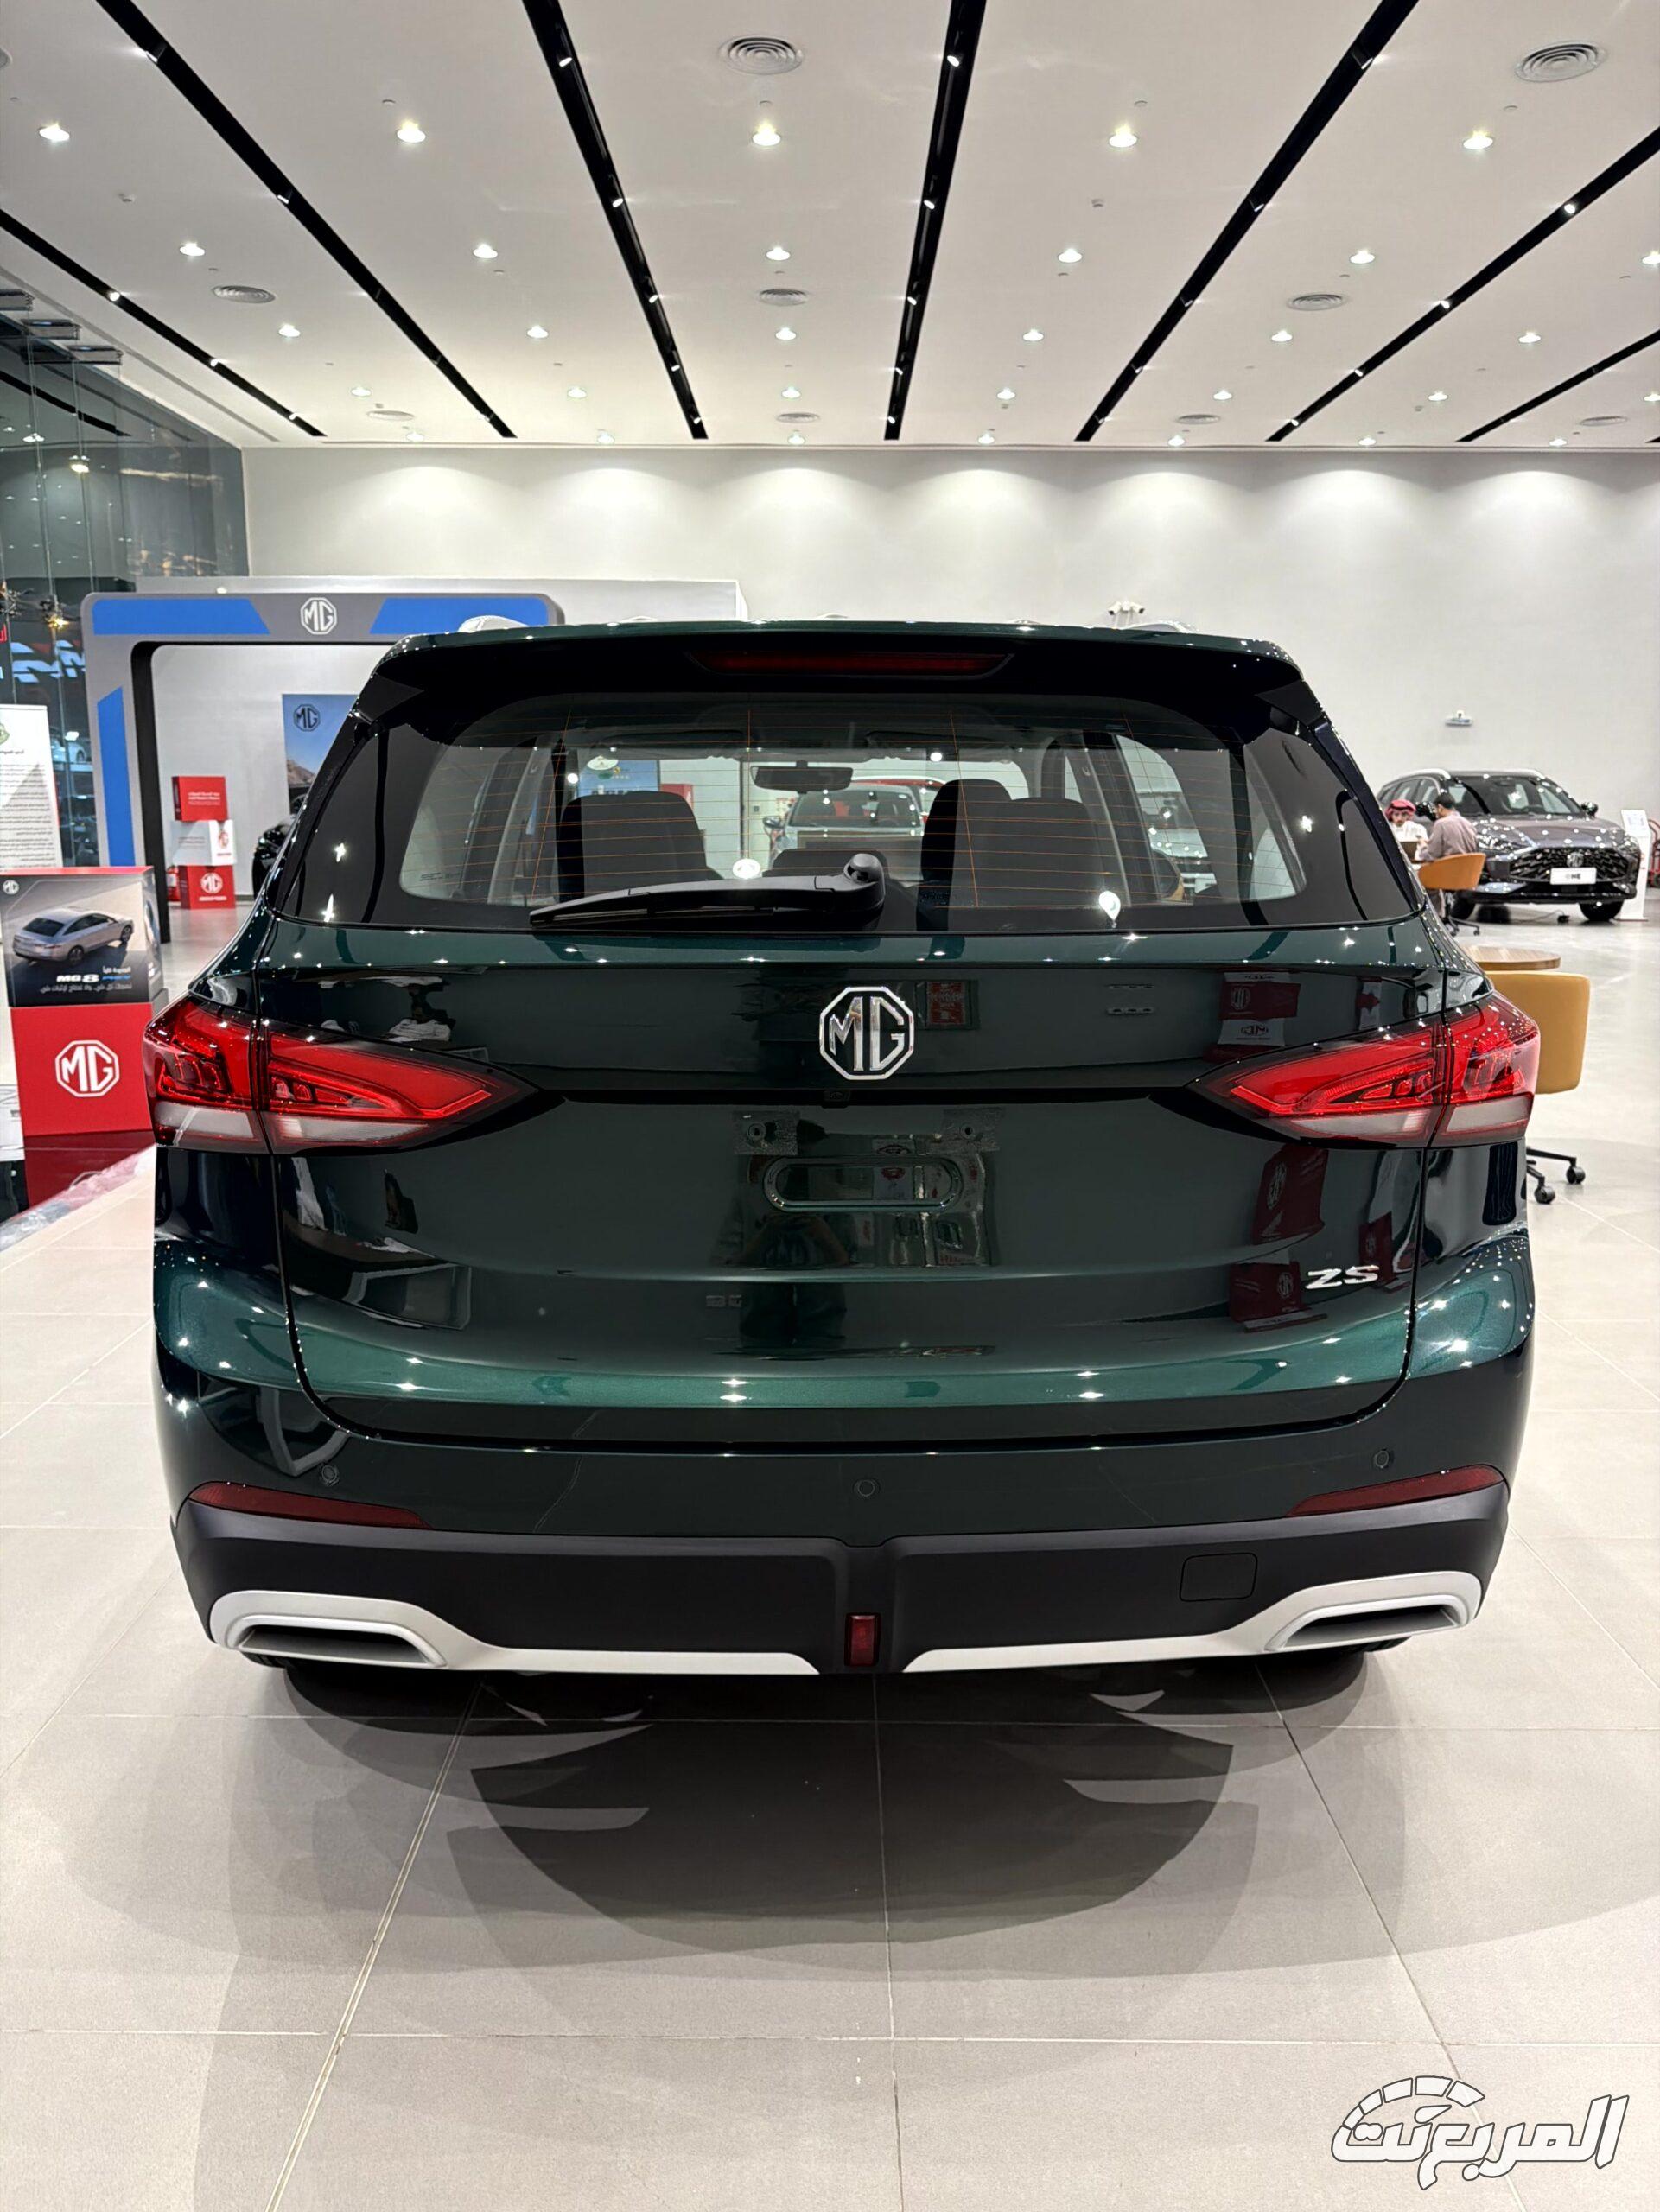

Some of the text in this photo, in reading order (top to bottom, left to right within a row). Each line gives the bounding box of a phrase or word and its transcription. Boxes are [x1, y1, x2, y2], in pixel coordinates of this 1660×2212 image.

[303, 601, 334, 632] MG
[296, 707, 319, 728] MG
[3, 880, 18, 894] MG
[202, 874, 222, 893] MG
[828, 995, 906, 1071] MG
[61, 1045, 114, 1092] MG
[1305, 1264, 1380, 1290] ZS
